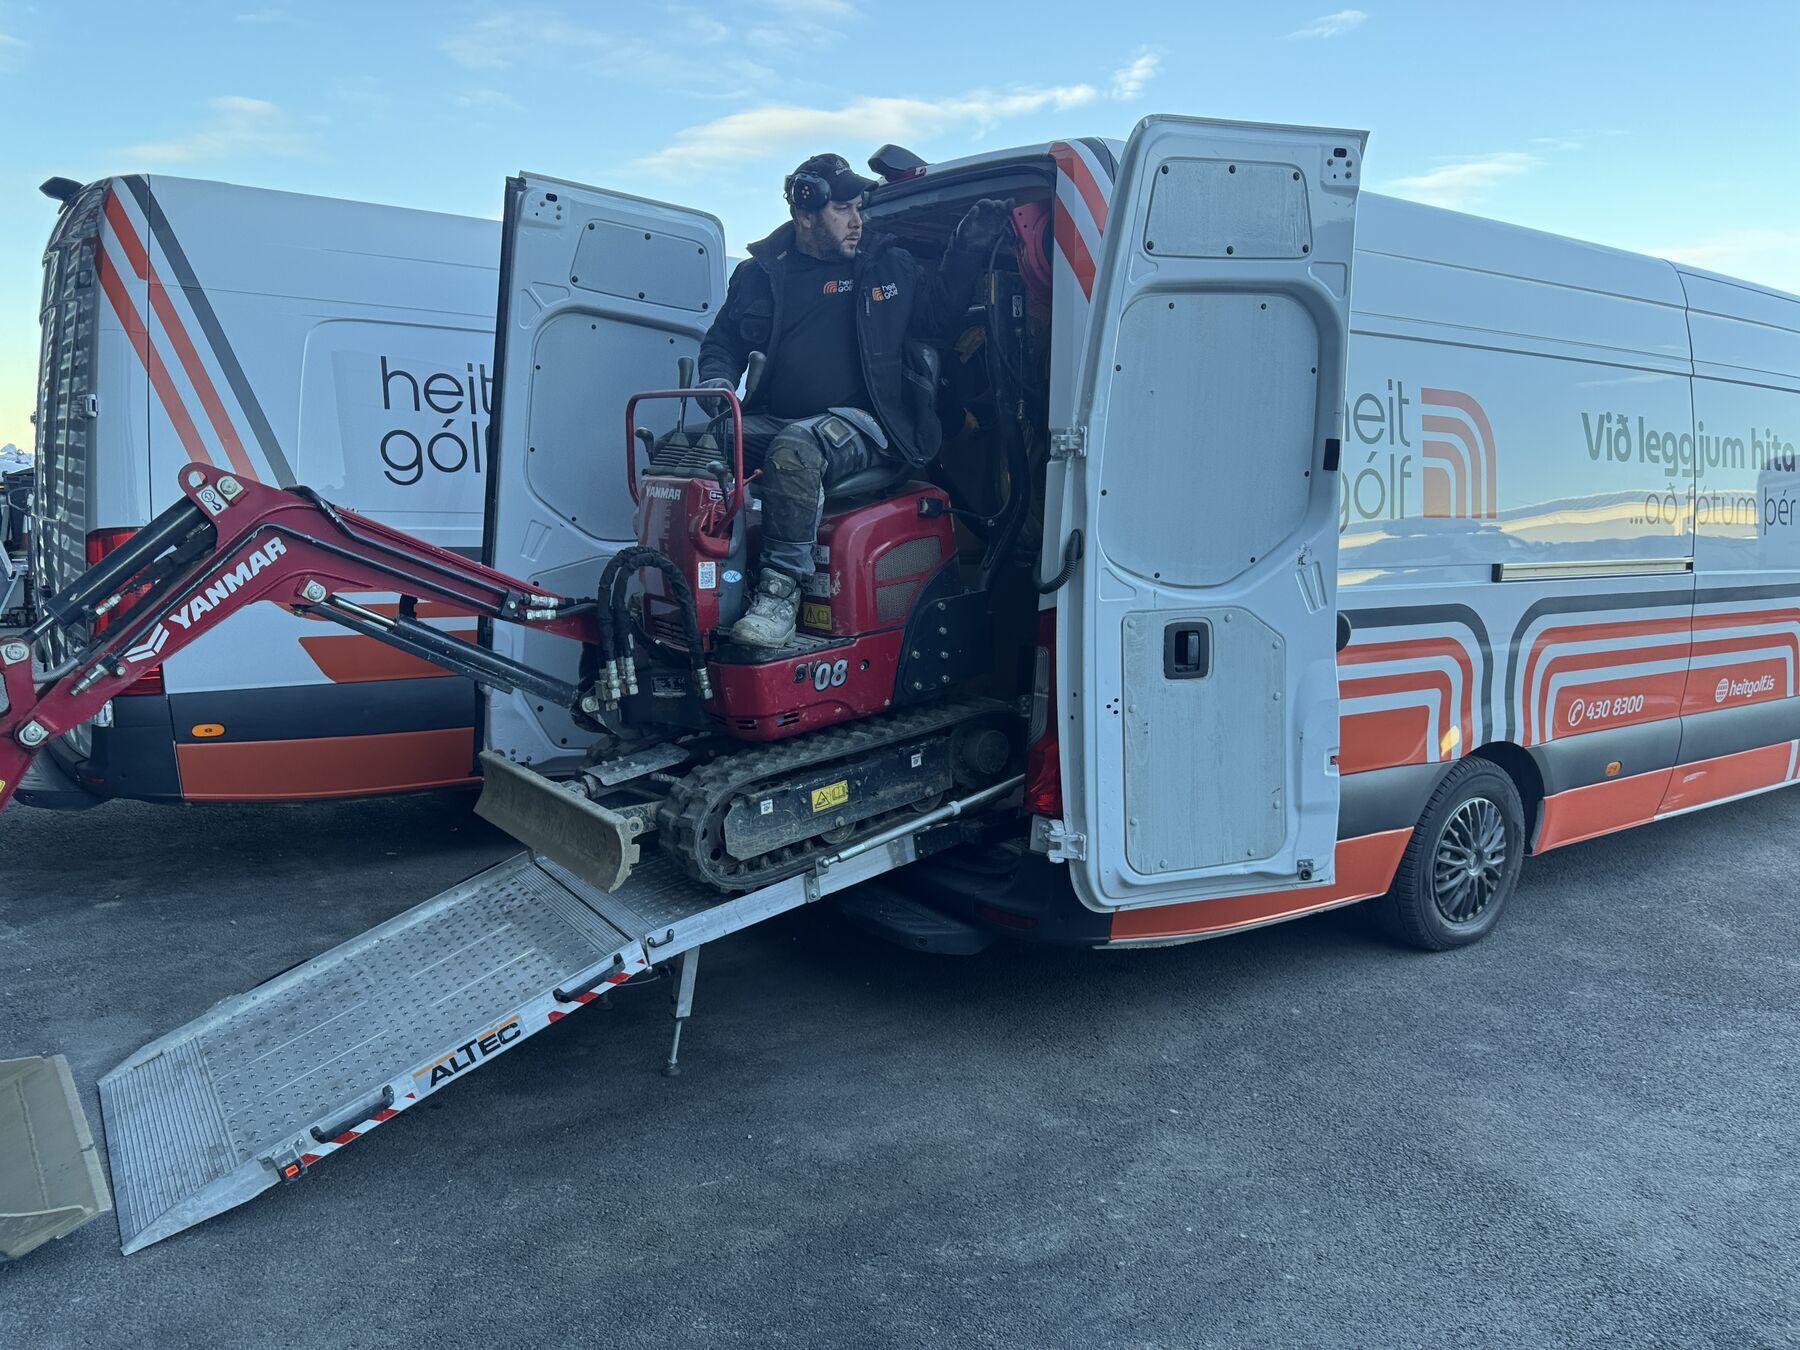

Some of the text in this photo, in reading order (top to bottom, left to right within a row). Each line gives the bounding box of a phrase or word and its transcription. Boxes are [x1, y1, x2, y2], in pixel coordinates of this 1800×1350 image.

[380, 418, 492, 486] gól
[1581, 411, 1796, 478] Við leggjum hita
[646, 486, 681, 500] YANMAR
[1687, 483, 1757, 526] fótum
[1763, 487, 1796, 536] þér
[168, 536, 287, 630] YANMAR
[724, 571, 738, 581] OK
[1586, 694, 1644, 718] 430 8300
[1729, 674, 1775, 698] heitgolf.is
[430, 1022, 522, 1088] ALTEC
